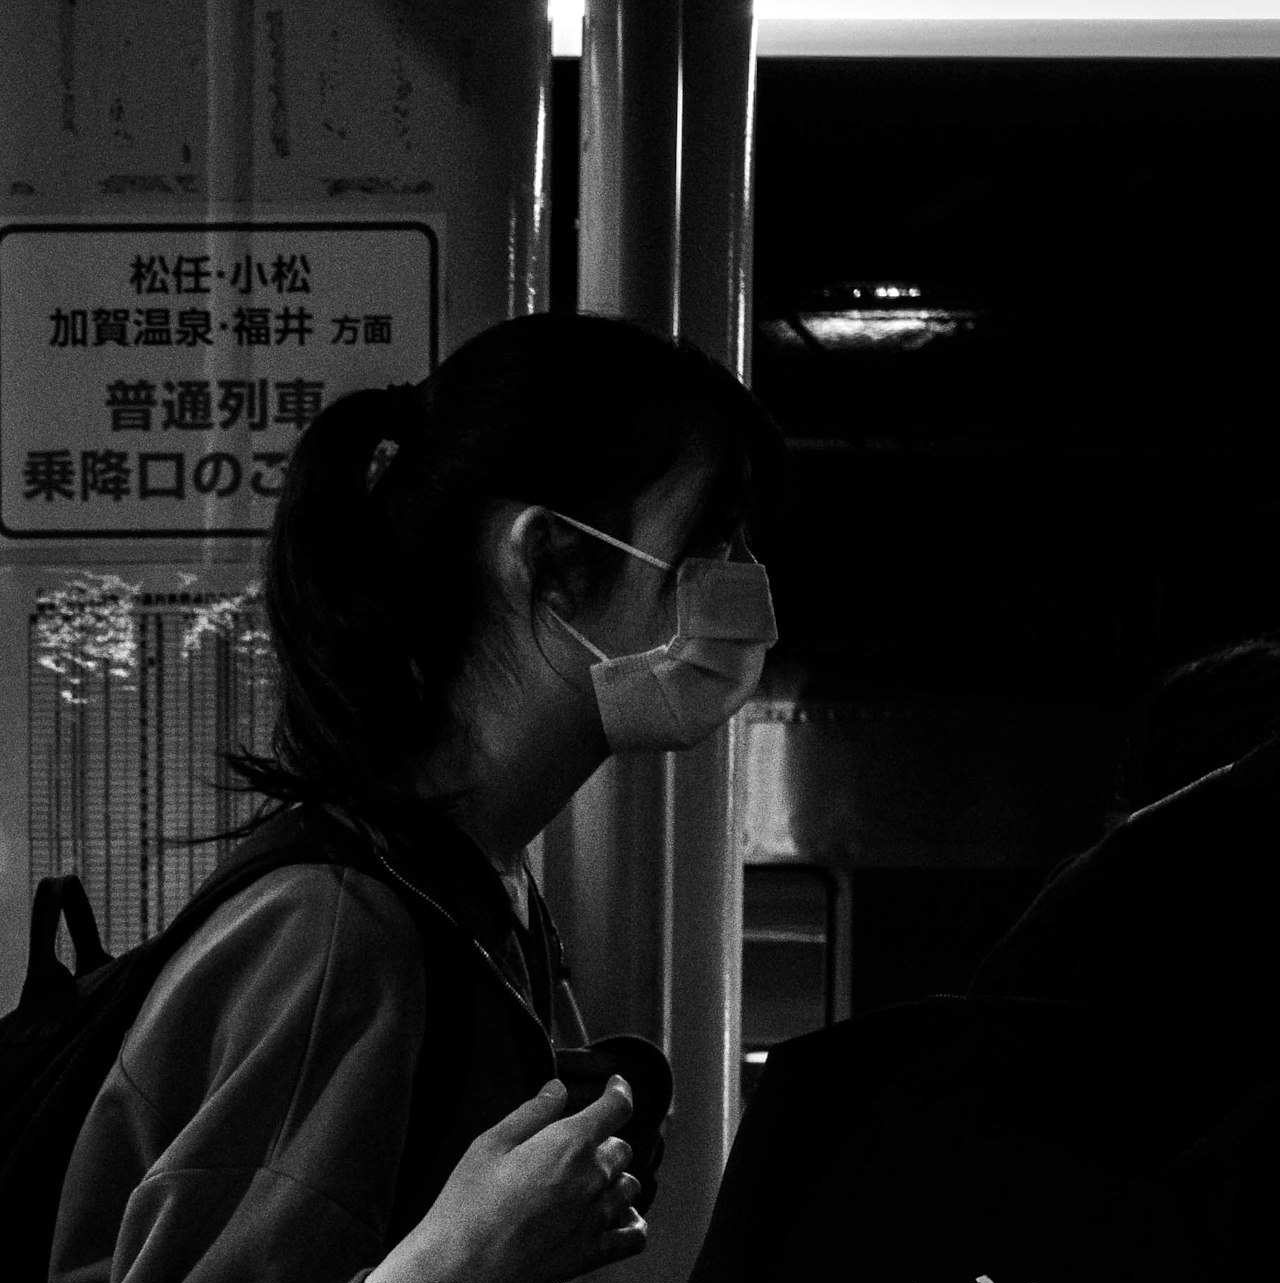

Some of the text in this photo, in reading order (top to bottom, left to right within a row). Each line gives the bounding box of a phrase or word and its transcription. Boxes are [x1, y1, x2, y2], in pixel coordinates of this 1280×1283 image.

[129, 254, 311, 295] 松任・小松
[48, 307, 393, 348] 加賀温泉・福井 方面
[105, 379, 325, 432] 普通列車
